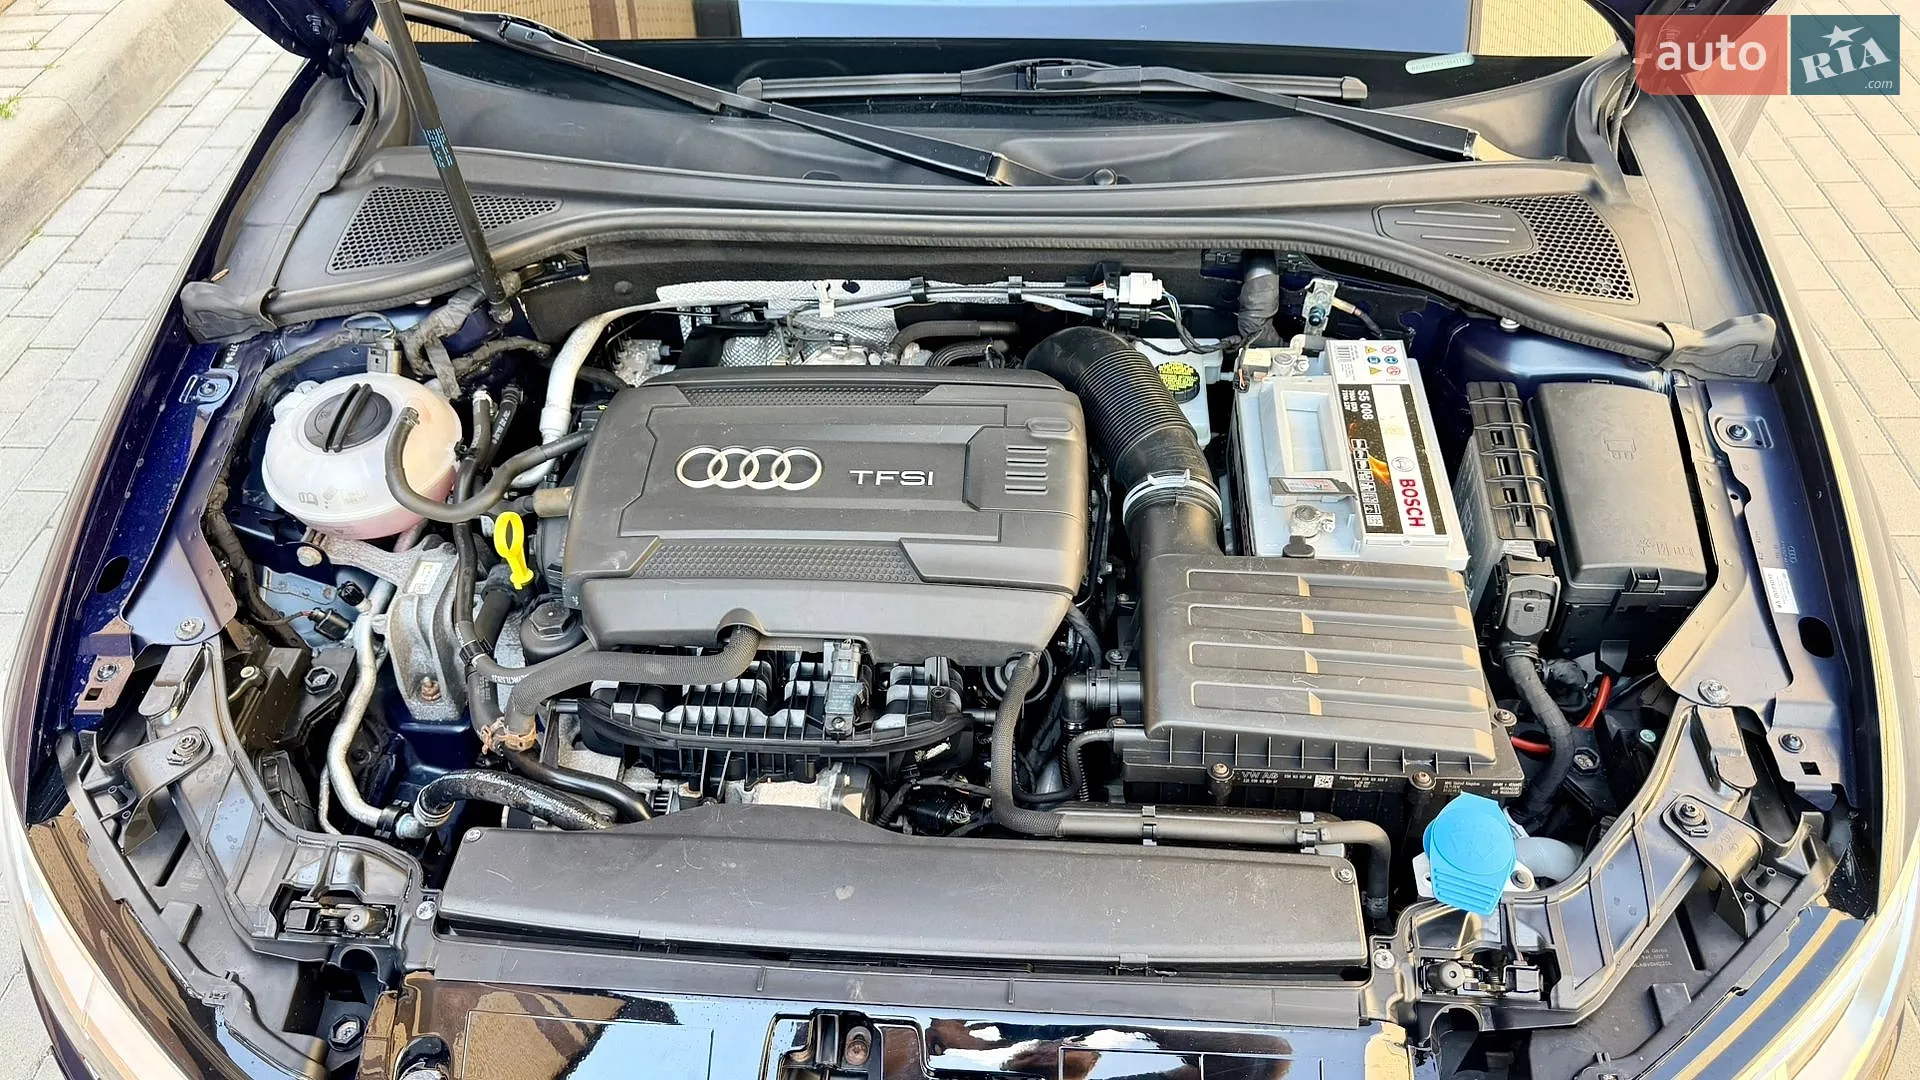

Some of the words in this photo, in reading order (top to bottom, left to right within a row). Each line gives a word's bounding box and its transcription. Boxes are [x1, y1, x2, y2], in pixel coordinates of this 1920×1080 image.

[1357, 389, 1371, 402] S5
[1360, 402, 1374, 420] 008
[849, 469, 934, 486] TFSI
[1399, 478, 1426, 527] BOSCH
[1241, 771, 1261, 779] VW
[1262, 771, 1279, 780] AG
